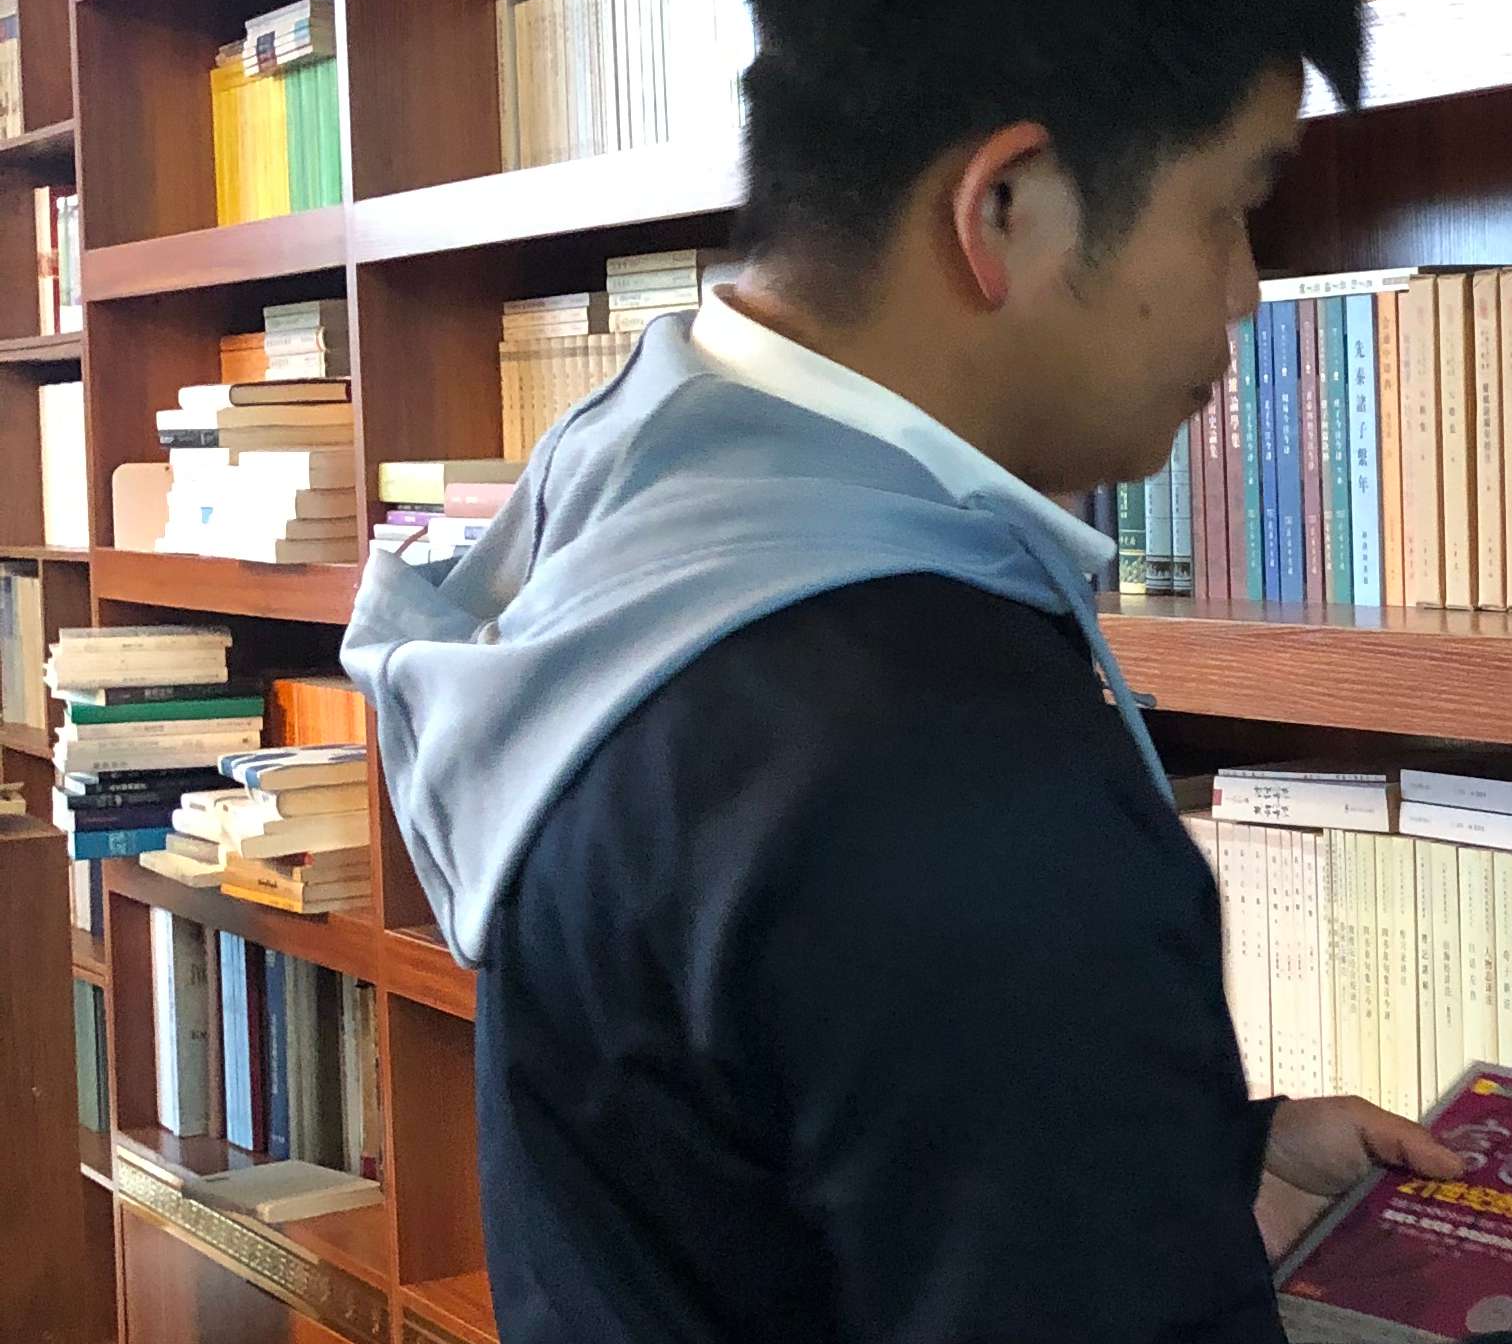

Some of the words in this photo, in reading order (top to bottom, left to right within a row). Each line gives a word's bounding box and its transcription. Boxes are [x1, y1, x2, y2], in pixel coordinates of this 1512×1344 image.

[1354, 340, 1369, 494] 先秦諸子繫年
